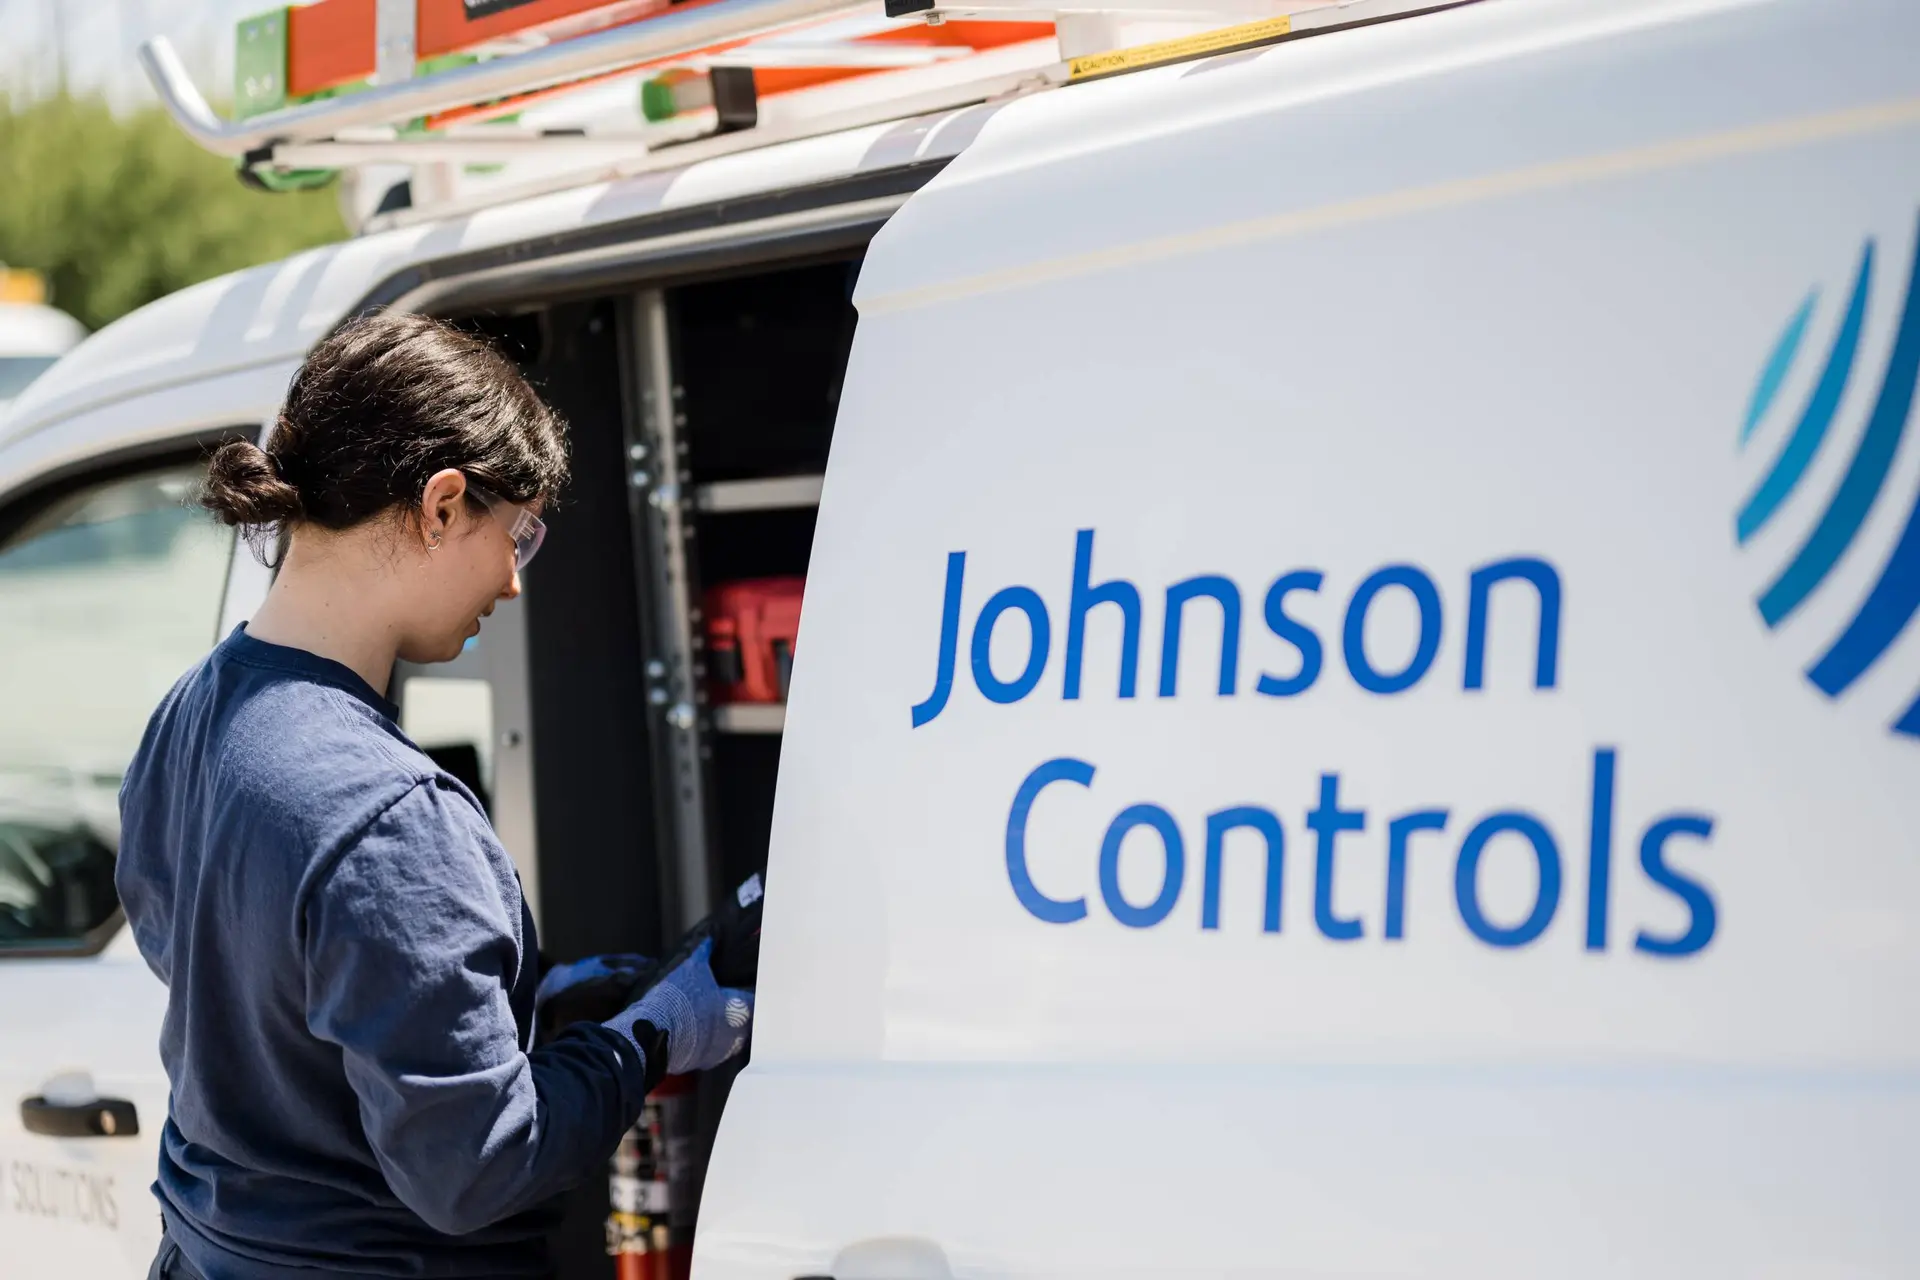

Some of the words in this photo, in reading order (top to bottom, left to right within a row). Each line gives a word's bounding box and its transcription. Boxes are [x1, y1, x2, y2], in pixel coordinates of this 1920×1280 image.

[1081, 54, 1125, 71] CAUTION
[911, 528, 1565, 729] Johnson
[1005, 747, 1719, 959] Controls
